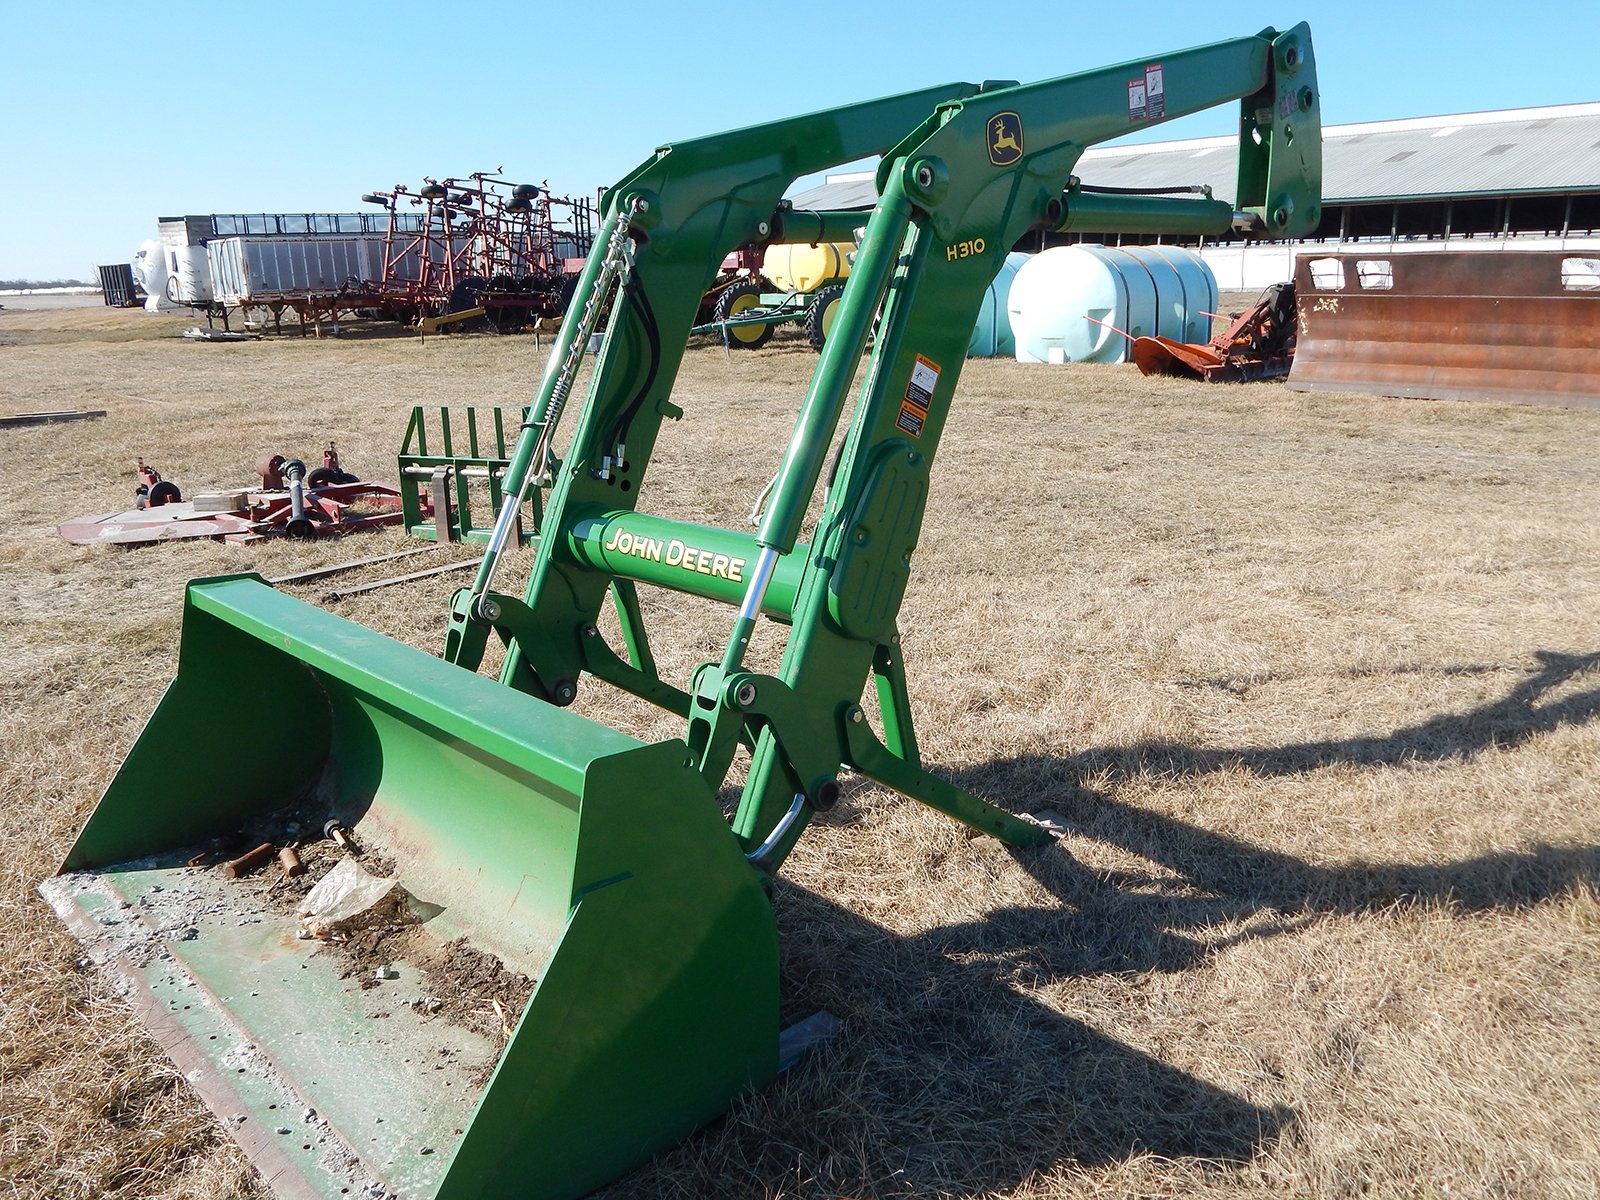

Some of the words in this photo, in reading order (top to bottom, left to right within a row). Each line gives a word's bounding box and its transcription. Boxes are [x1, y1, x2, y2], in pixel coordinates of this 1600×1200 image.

[946, 238, 986, 262] H310
[605, 527, 664, 563] JOHN
[665, 539, 746, 583] DEERE
